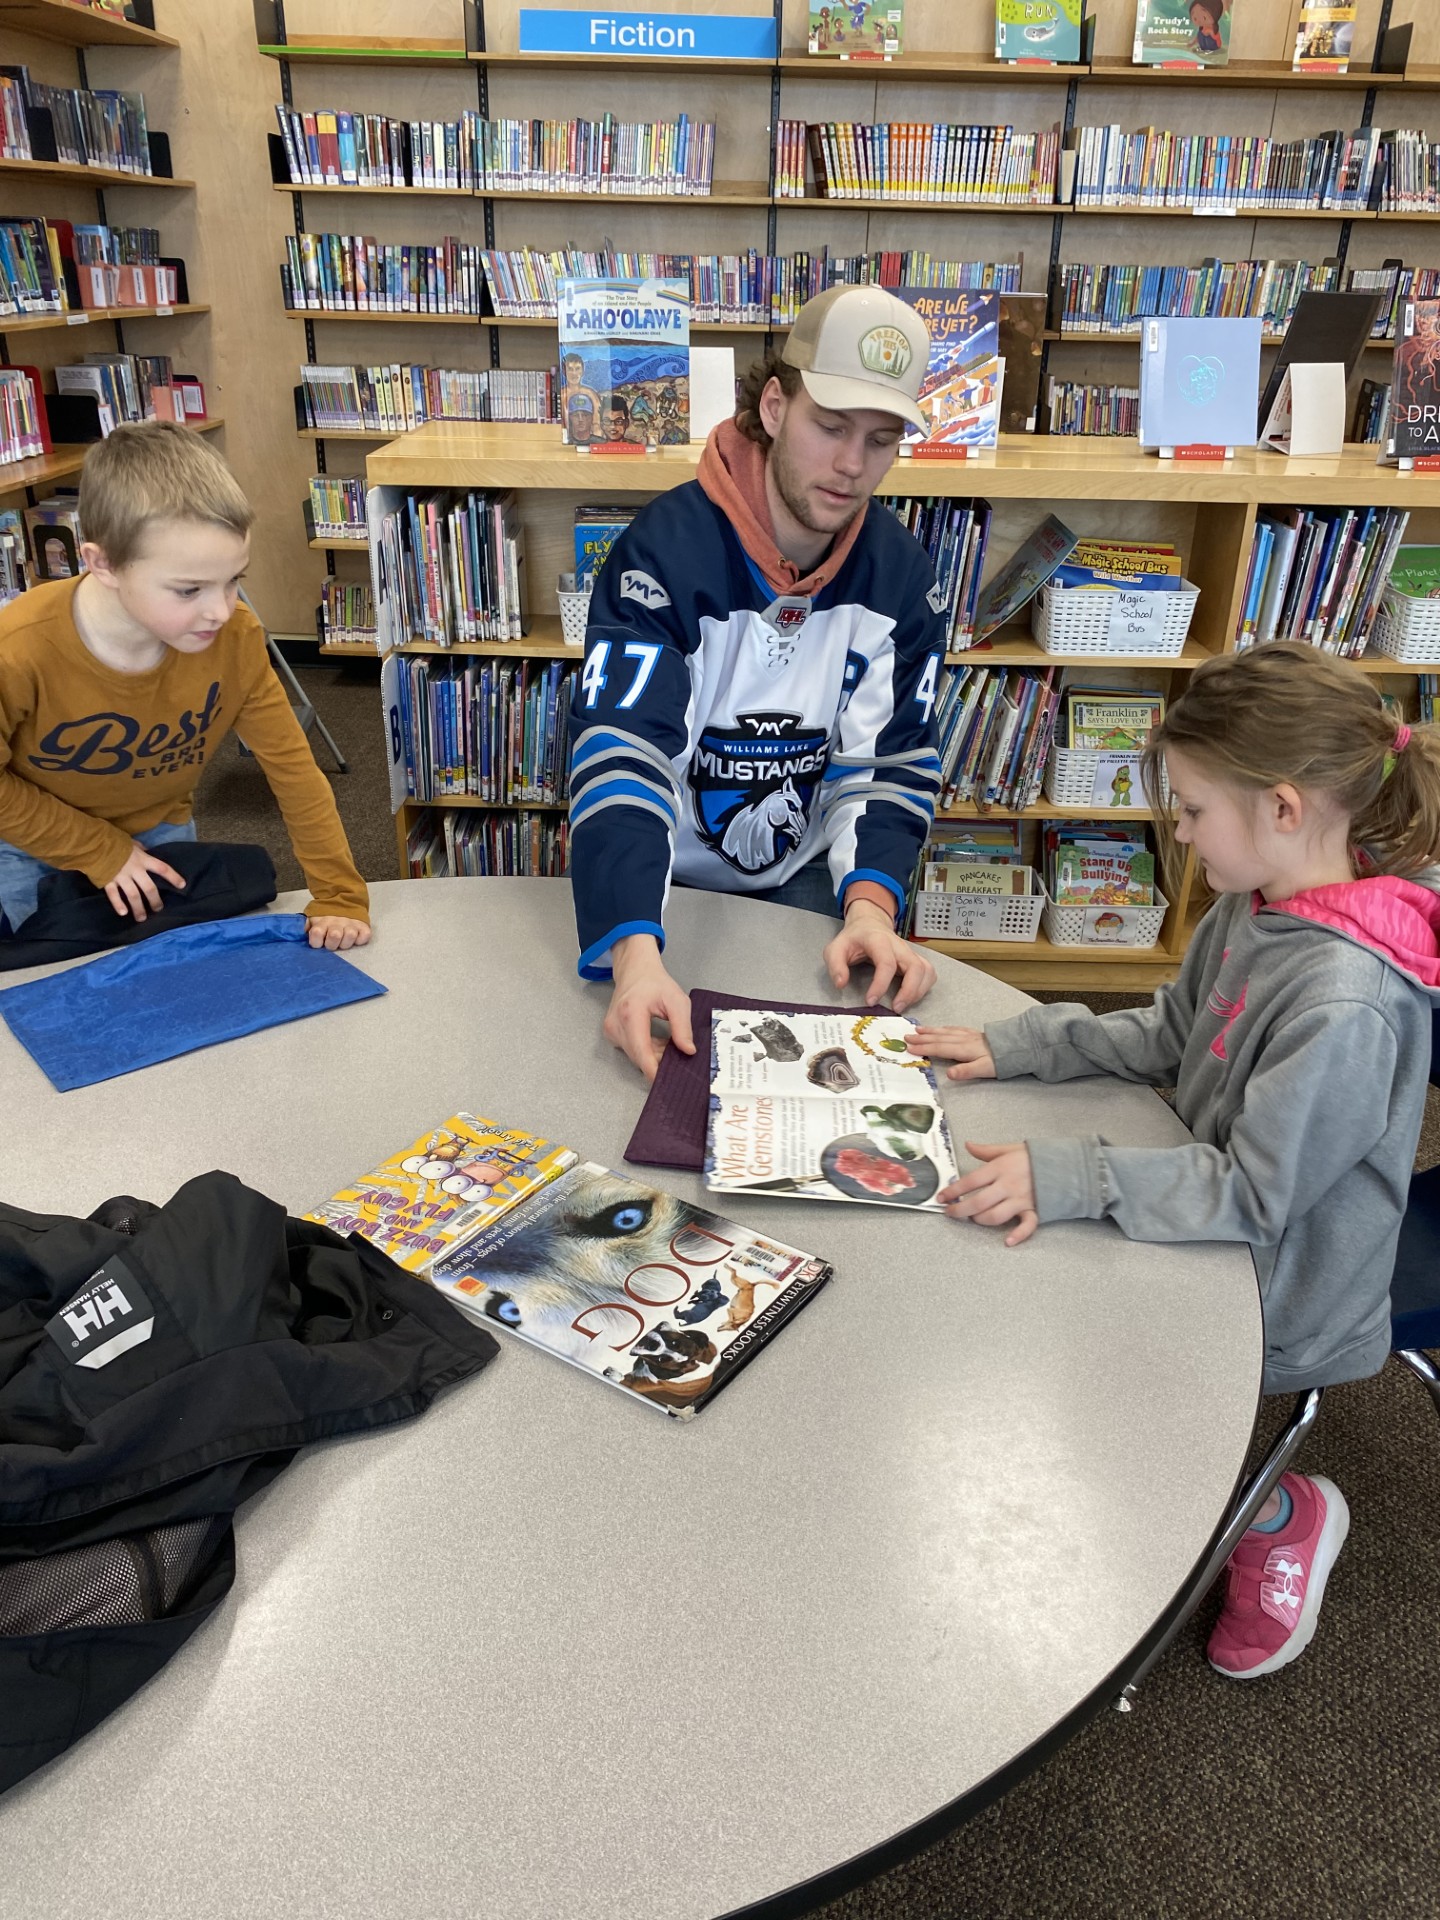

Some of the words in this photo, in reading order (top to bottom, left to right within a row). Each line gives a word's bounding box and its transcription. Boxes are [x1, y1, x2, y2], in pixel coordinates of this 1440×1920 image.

[1024, 3, 1053, 19] RUN
[1153, 16, 1190, 26] Trudy's
[590, 20, 695, 48] Fiction
[1148, 27, 1169, 35] Rock
[1171, 27, 1194, 36] Story
[913, 297, 943, 318] ARE
[945, 294, 969, 315] WE
[935, 314, 979, 340] YET?
[1408, 405, 1440, 423] DR
[1408, 427, 1423, 437] TO
[584, 540, 612, 554] FLY
[1082, 553, 1111, 567] Magic
[1111, 558, 1146, 570] School
[1147, 561, 1168, 575] Bus
[1405, 568, 1438, 577] Planet
[1093, 571, 1111, 579] Wild
[1112, 573, 1143, 583] Weather
[1119, 593, 1146, 608] Magic
[1121, 608, 1154, 619] School
[1128, 623, 1145, 633] Bus
[581, 639, 665, 710] 47
[1096, 708, 1138, 717] Franklin
[28, 681, 222, 776] Best
[389, 704, 402, 765] B
[160, 737, 206, 765] BRO
[723, 744, 779, 754] WILLIAMS
[785, 743, 809, 753] LAKE
[132, 751, 204, 779] EVER!
[692, 746, 827, 781] MUSTANGS
[1080, 857, 1113, 867] Stand
[1117, 860, 1132, 872] Up
[960, 871, 1002, 884] PANCAKES
[1081, 870, 1130, 885] Bullying
[956, 885, 1003, 895] BREAKFAST
[955, 896, 984, 905] Books
[988, 896, 998, 907] by
[957, 906, 987, 917] Tomie
[963, 917, 974, 926] de
[731, 1103, 750, 1130] Are
[477, 1125, 515, 1143] Arnold
[720, 1136, 746, 1180] What
[353, 1189, 405, 1211] GUY
[553, 1193, 567, 1206] the
[404, 1200, 456, 1222] FLY
[328, 1214, 382, 1237] BOY
[384, 1213, 423, 1228] AND
[503, 1216, 531, 1240] history
[380, 1226, 449, 1255] BUZZ
[484, 1224, 502, 1241] pets
[470, 1237, 487, 1252] and
[476, 1240, 498, 1260] dogs
[495, 1236, 507, 1248] of
[450, 1247, 473, 1267] show
[450, 1261, 473, 1280] from
[799, 1261, 821, 1283] DK
[91, 1278, 115, 1295] HELLY
[570, 1221, 736, 1353] DOG
[59, 1292, 91, 1316] HANSEN
[63, 1284, 133, 1342] HH
[757, 1280, 806, 1331] EYEWITNESS
[722, 1331, 757, 1361] BOOKS
